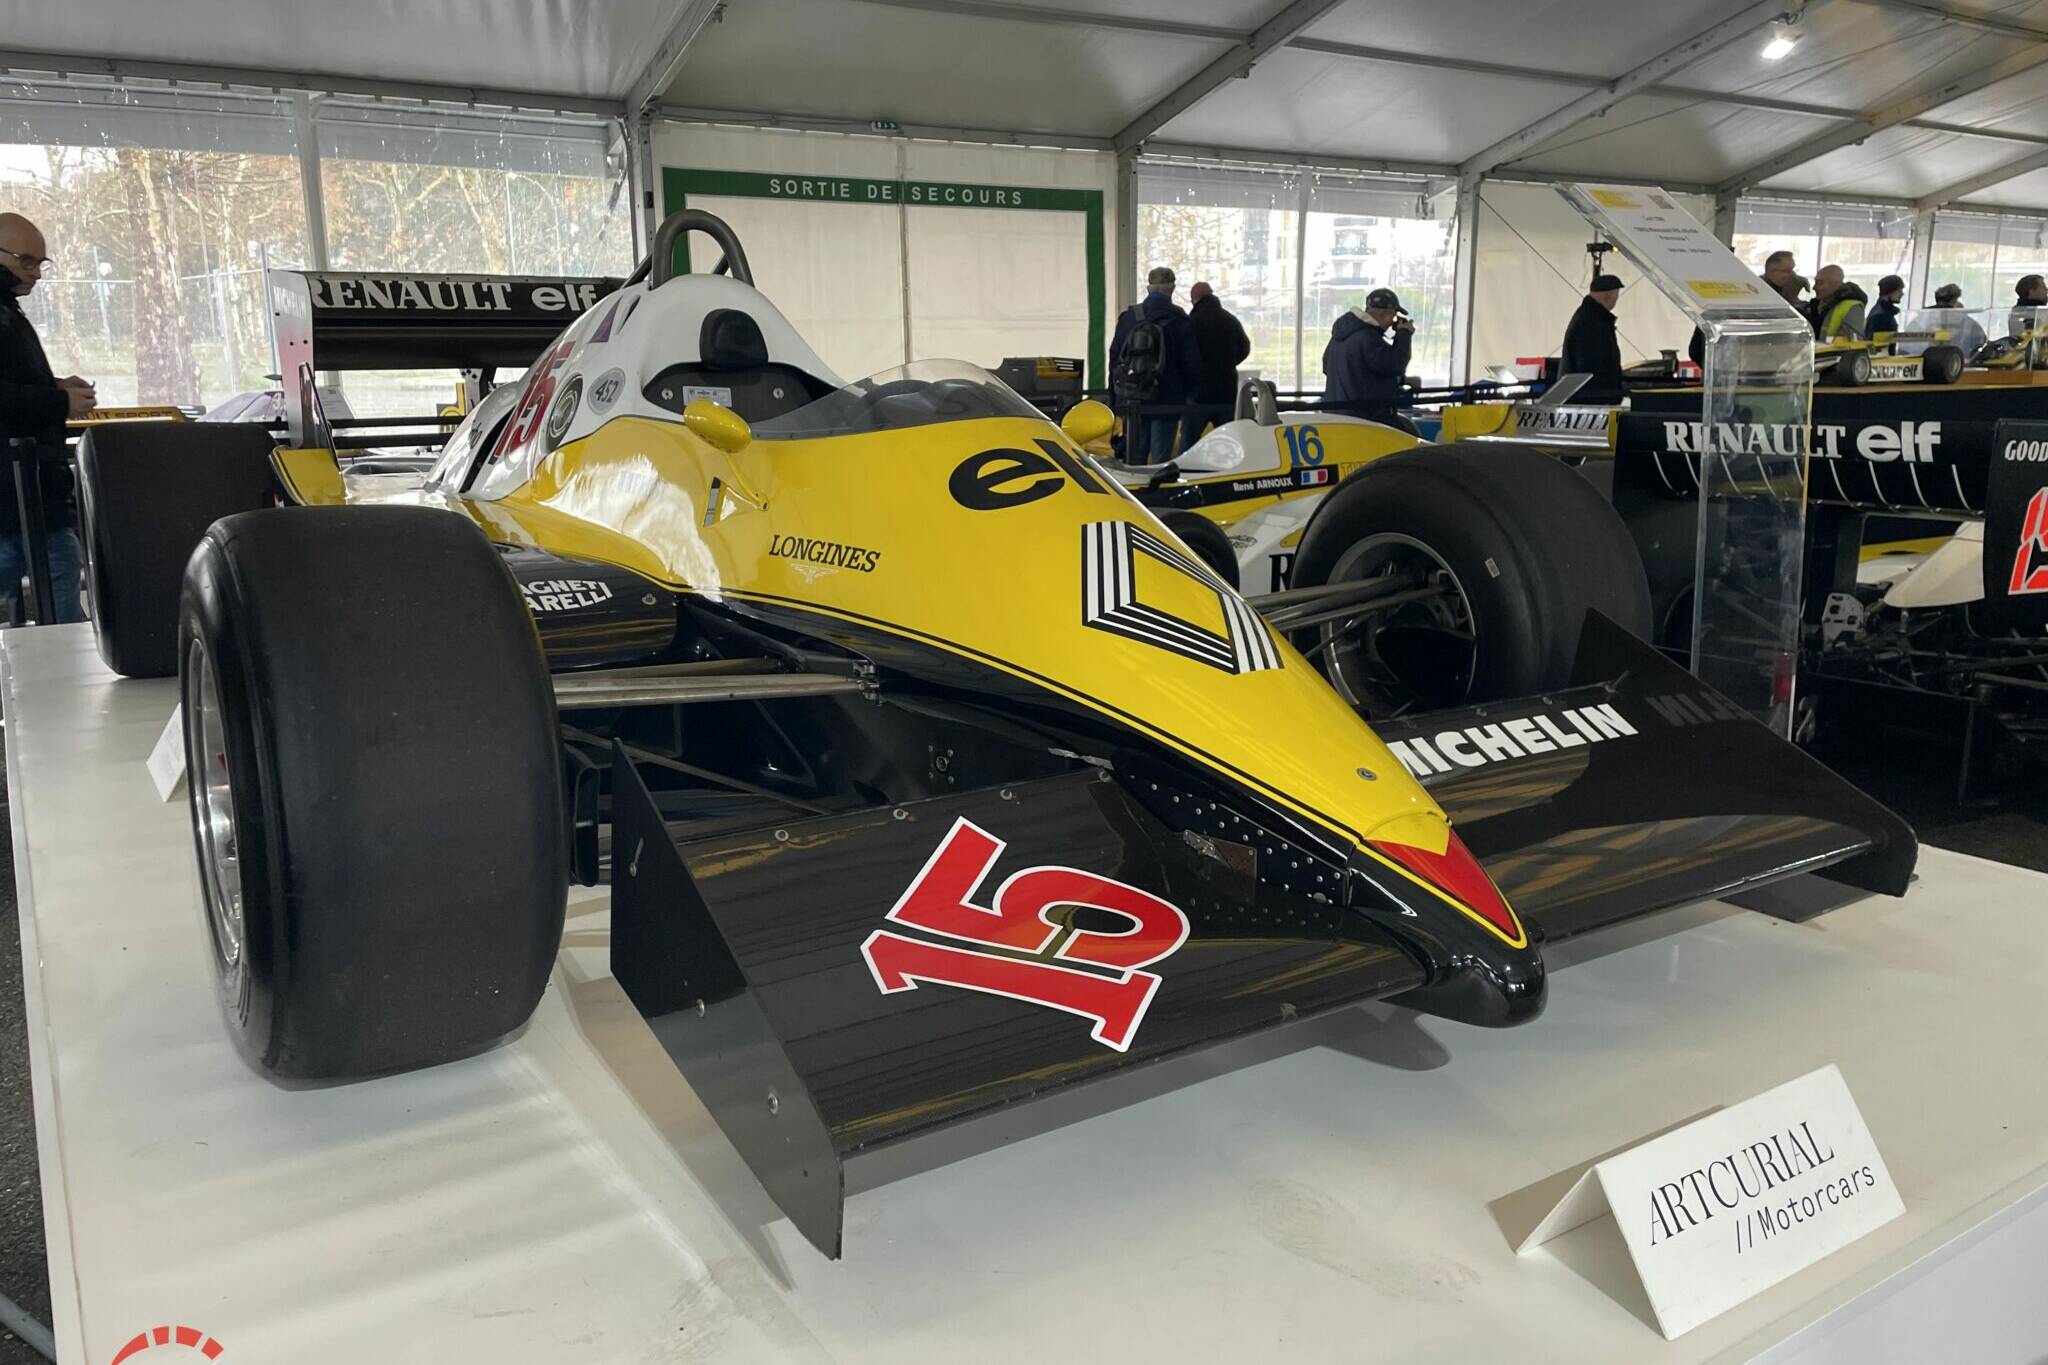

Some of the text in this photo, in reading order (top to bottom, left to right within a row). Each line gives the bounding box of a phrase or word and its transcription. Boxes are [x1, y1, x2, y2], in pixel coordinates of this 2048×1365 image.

[769, 178, 1022, 205] SORTIE DE SECOURS
[531, 283, 597, 312] elf
[1283, 424, 1325, 466] 16
[1664, 421, 1942, 463] RENAULT elf
[948, 438, 1112, 511] el
[1233, 477, 1294, 492] René ARNOUX
[768, 534, 881, 573] LONGINES
[860, 815, 1190, 1053] 15
[1650, 1121, 1835, 1247] ARTCURIAL
[1735, 1165, 1876, 1254] //Motorcars
